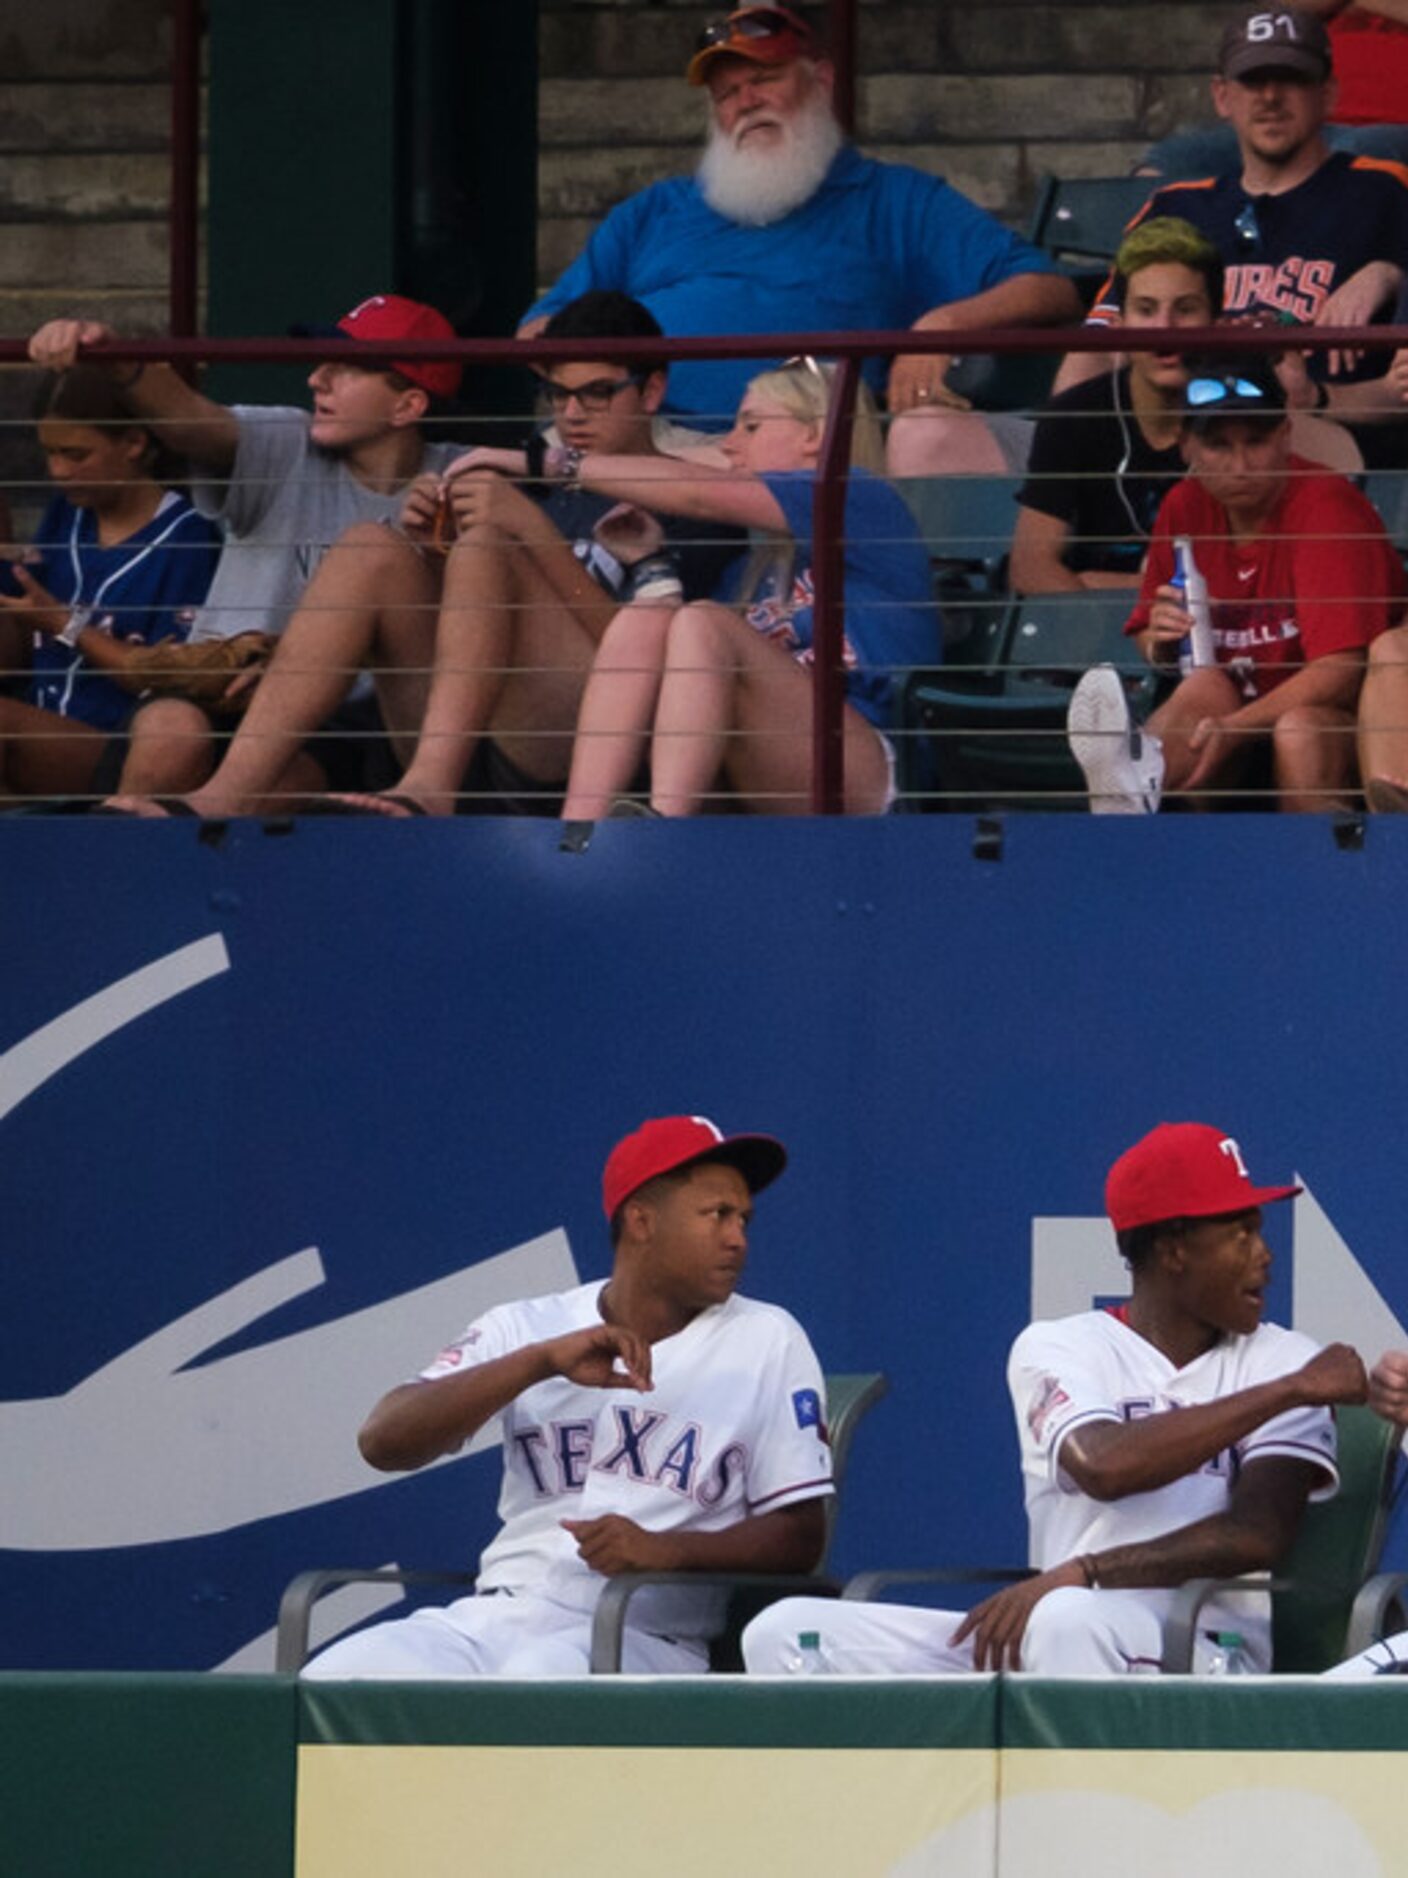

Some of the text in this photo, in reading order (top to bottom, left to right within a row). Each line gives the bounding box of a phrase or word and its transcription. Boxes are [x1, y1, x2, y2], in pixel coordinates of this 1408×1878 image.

[1246, 13, 1297, 41] 51
[1219, 1137, 1249, 1177] T
[513, 1404, 748, 1508] TEXAS
